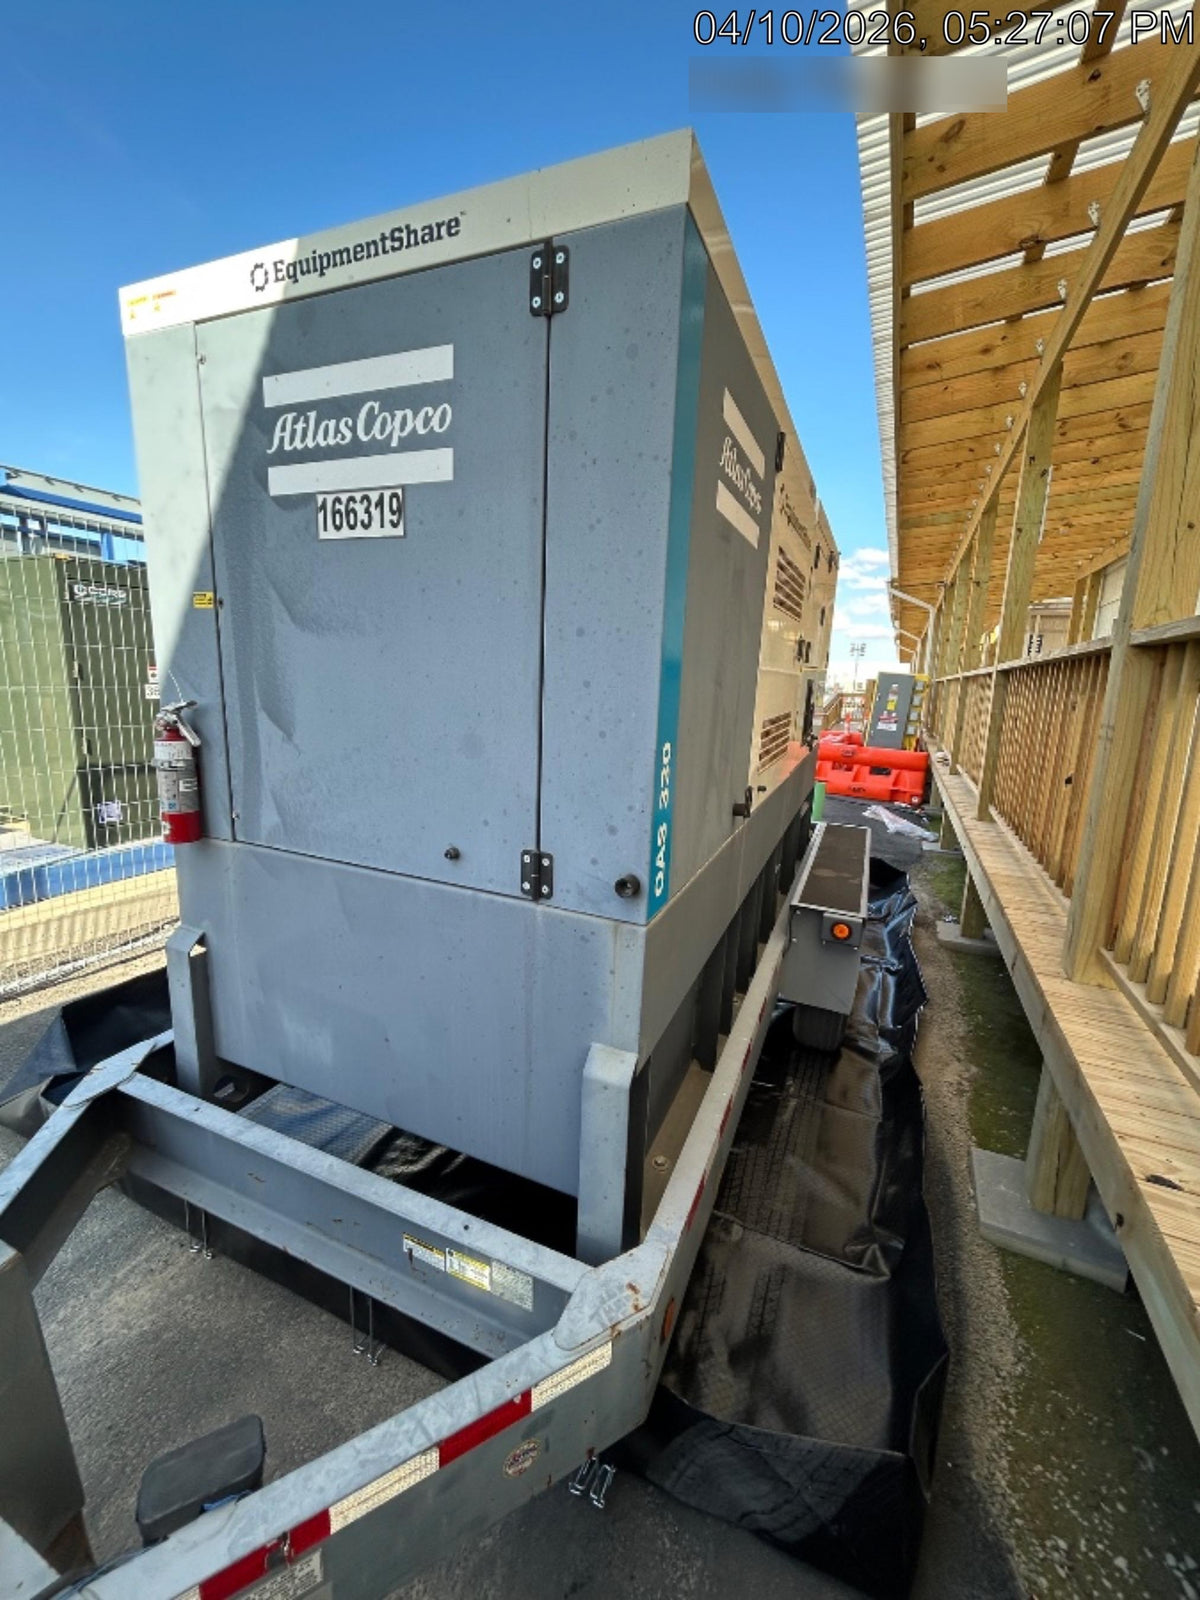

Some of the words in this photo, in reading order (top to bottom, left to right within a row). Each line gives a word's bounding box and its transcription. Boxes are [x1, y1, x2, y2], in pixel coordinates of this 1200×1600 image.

[273, 216, 461, 285] EquipmentShare
[266, 410, 353, 454] Atlas
[357, 401, 452, 447] Copco
[318, 492, 402, 532] 166319
